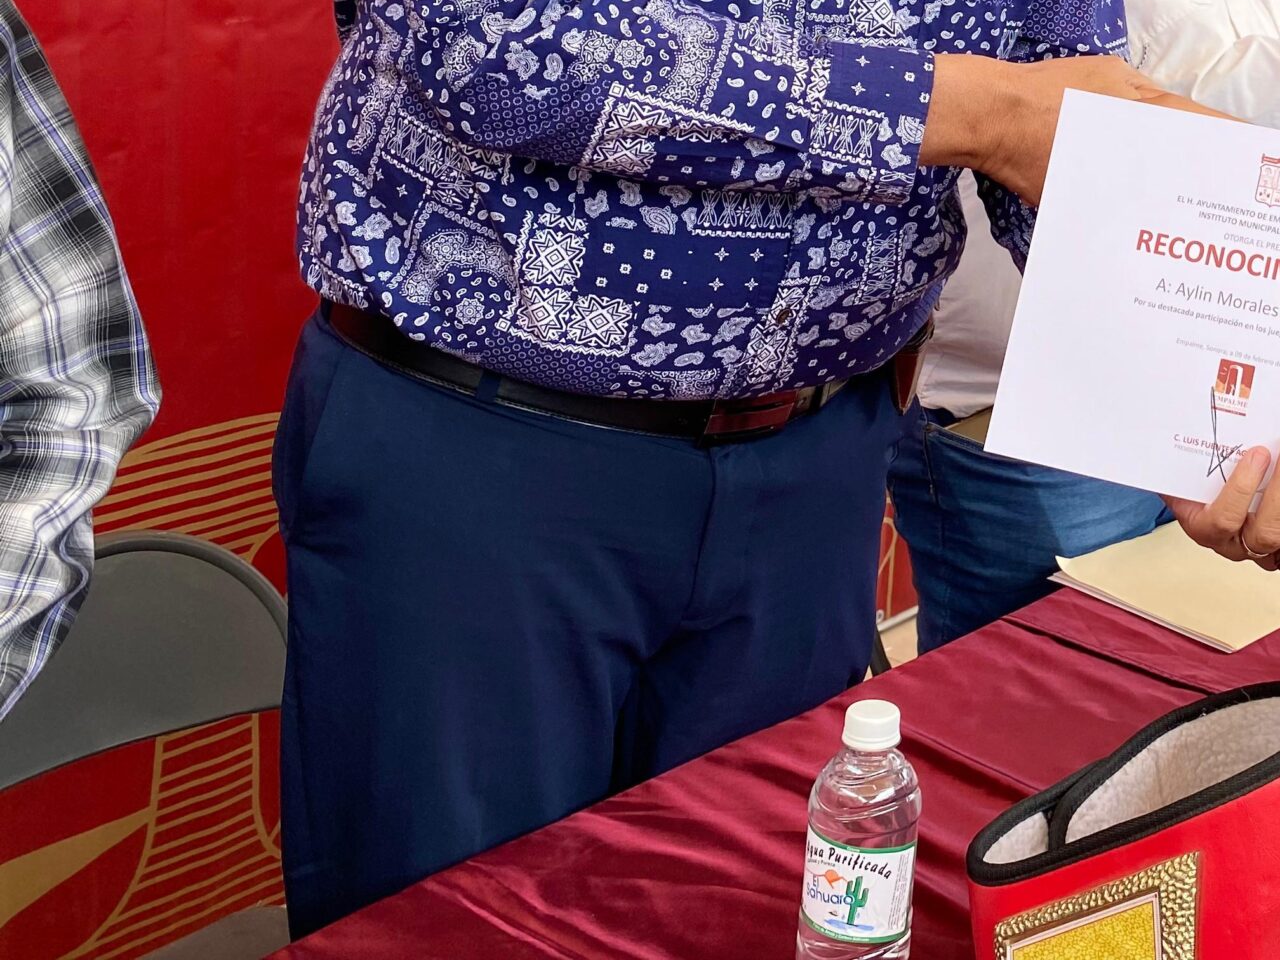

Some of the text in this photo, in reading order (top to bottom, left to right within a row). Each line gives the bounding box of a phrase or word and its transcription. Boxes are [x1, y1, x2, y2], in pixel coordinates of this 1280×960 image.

[1177, 195, 1186, 204] EL
[1187, 197, 1194, 205] H.
[1197, 199, 1256, 218] AYUNTAMIENTO
[1257, 211, 1268, 220] DE
[1198, 211, 1238, 225] INSTITUTO
[1238, 219, 1280, 235] MUNICIPAL
[1223, 232, 1255, 247] OTORGA
[1256, 239, 1265, 248] EL
[1155, 278, 1172, 294] A:
[1175, 282, 1213, 303] Aylin
[1217, 290, 1279, 317] Morales
[1133, 297, 1146, 306] Por
[1157, 302, 1194, 317] destacada
[1195, 311, 1243, 328] participación
[1244, 322, 1254, 330] en
[1256, 323, 1267, 333] los
[1183, 436, 1199, 446] LUIS
[828, 847, 892, 880] Purificada
